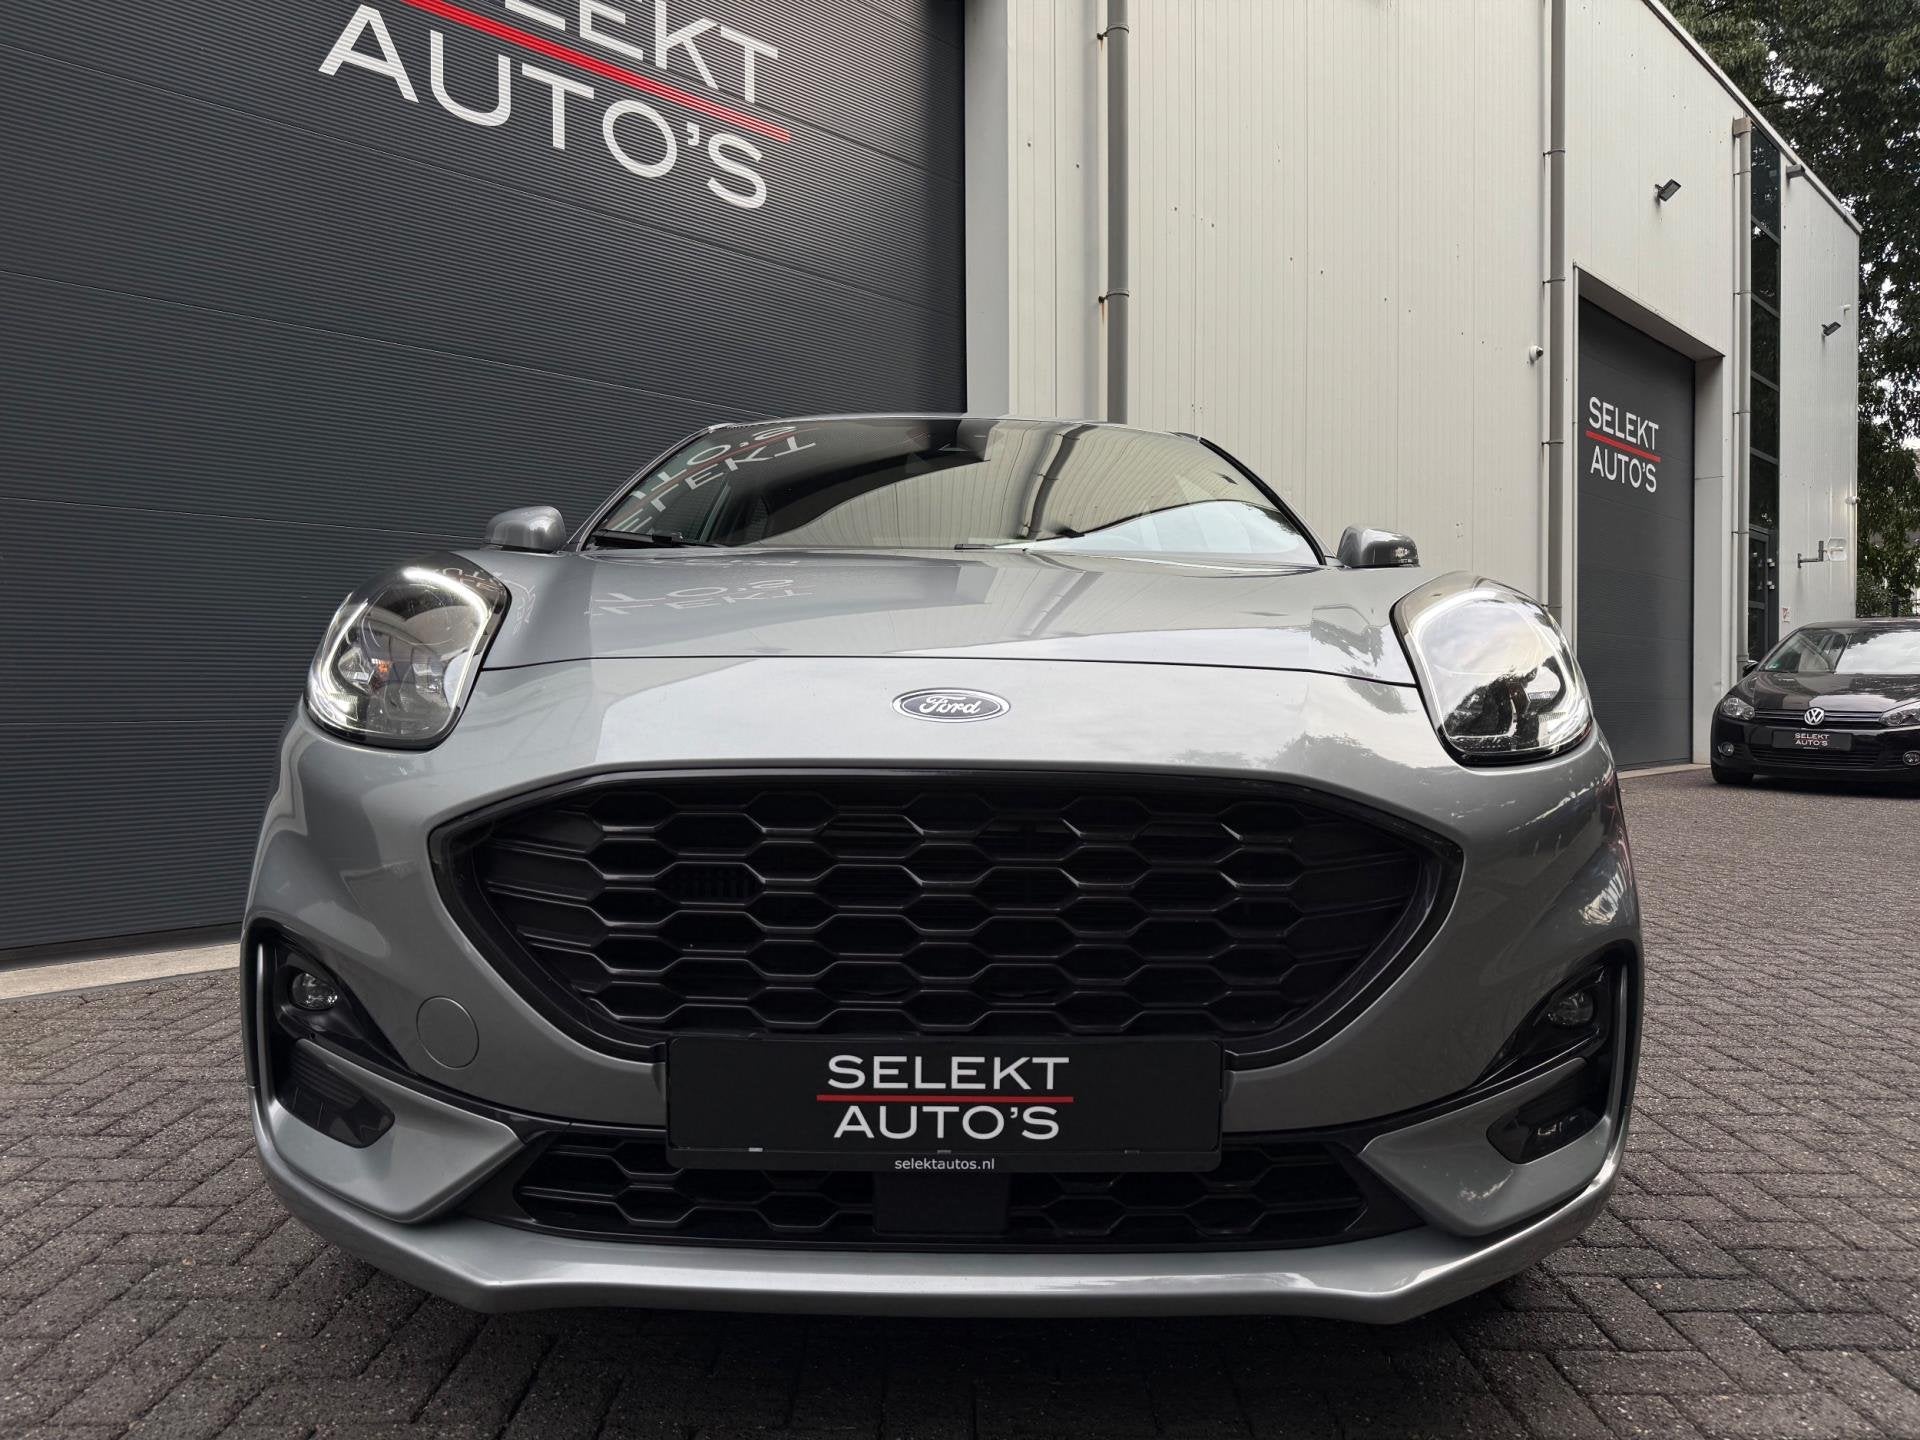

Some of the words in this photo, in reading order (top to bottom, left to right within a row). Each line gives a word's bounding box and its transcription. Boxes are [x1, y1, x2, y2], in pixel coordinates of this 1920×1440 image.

[318, 4, 768, 209] AUTO'S
[1588, 396, 1660, 451] SELEKT
[1590, 445, 1657, 493] AUTO'S
[919, 695, 981, 714] Ford
[1795, 732, 1829, 740] SELEKT
[1795, 739, 1828, 747] AUTO'S
[827, 1054, 1070, 1090] SELEKT
[833, 1105, 1060, 1140] AUTO'S
[894, 1156, 995, 1171] selektautos.nl
